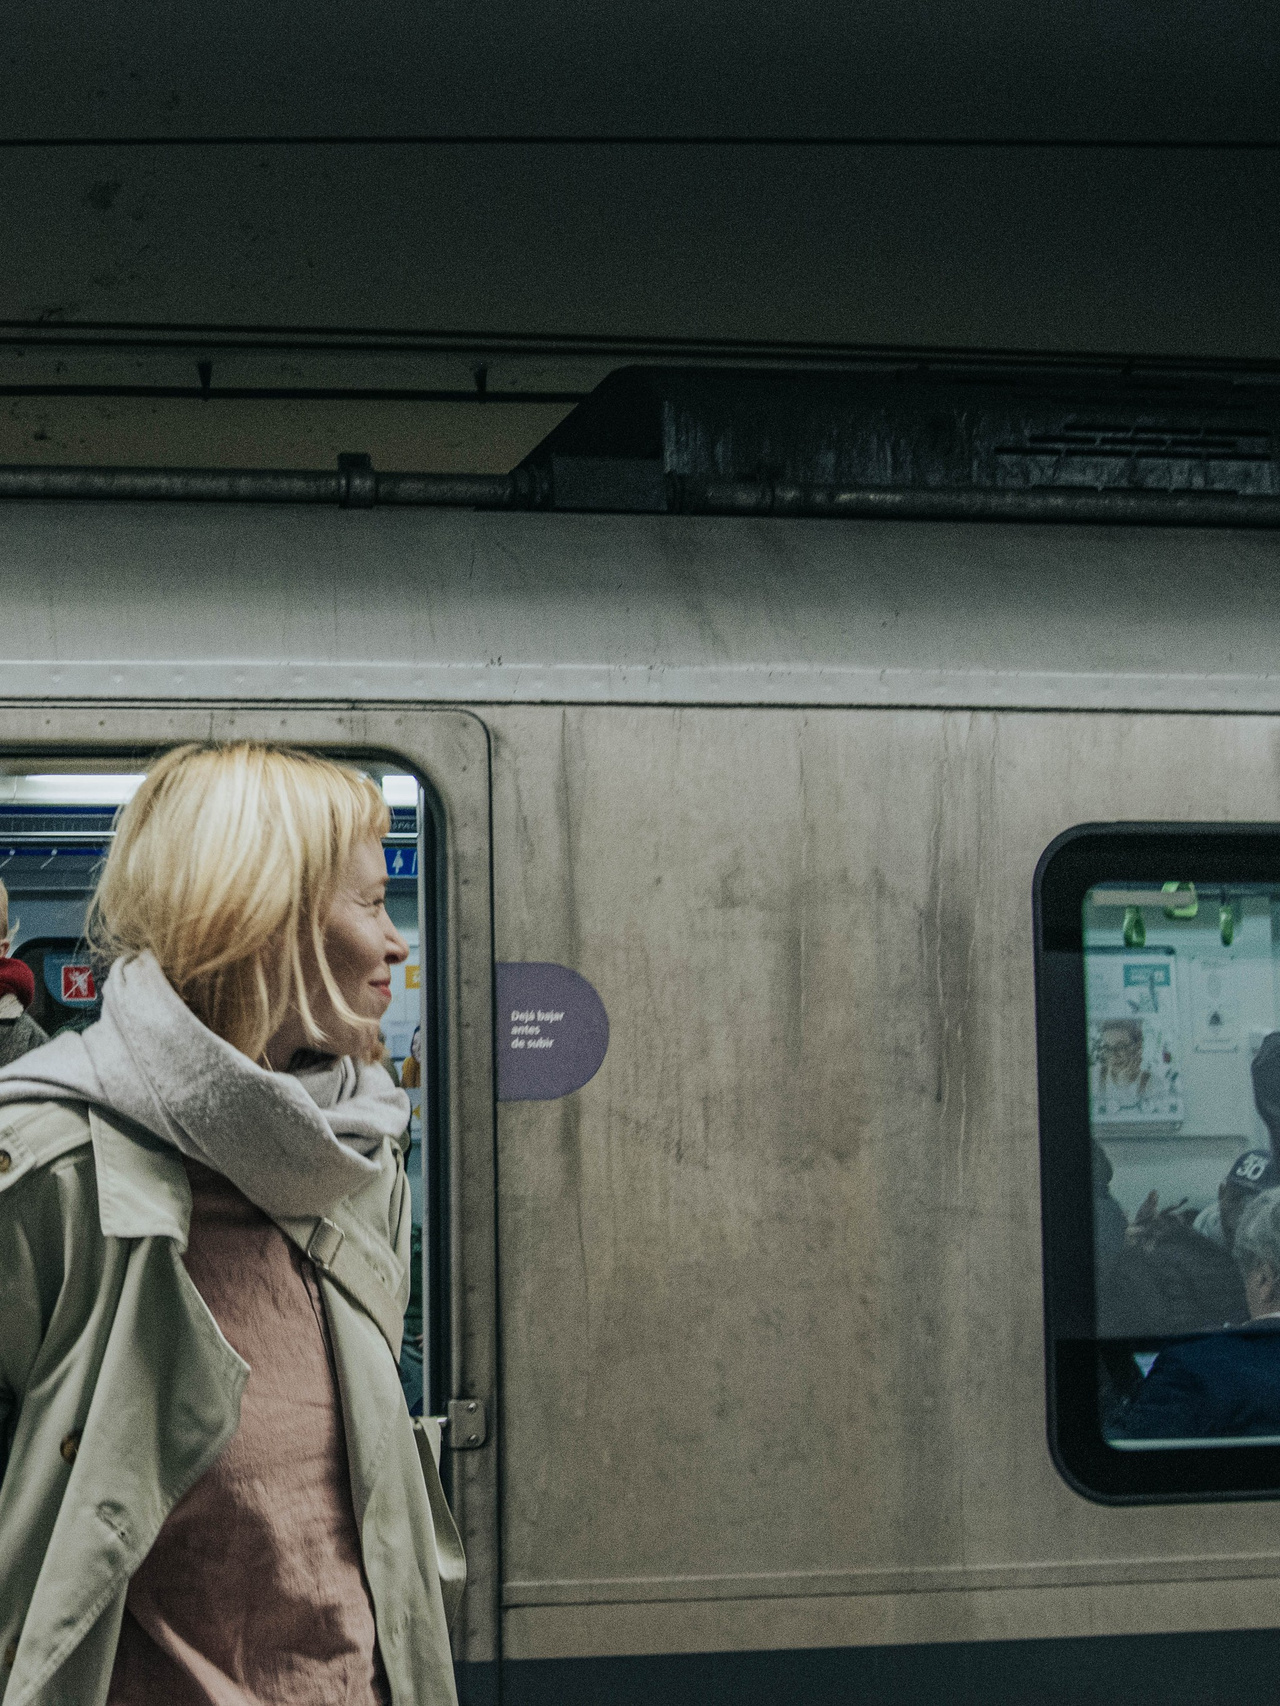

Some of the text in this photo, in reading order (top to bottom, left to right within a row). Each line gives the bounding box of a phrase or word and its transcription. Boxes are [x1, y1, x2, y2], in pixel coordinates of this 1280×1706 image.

[537, 1010, 565, 1024] bajar
[511, 1025, 540, 1035] antes
[511, 1037, 554, 1048] de subir
